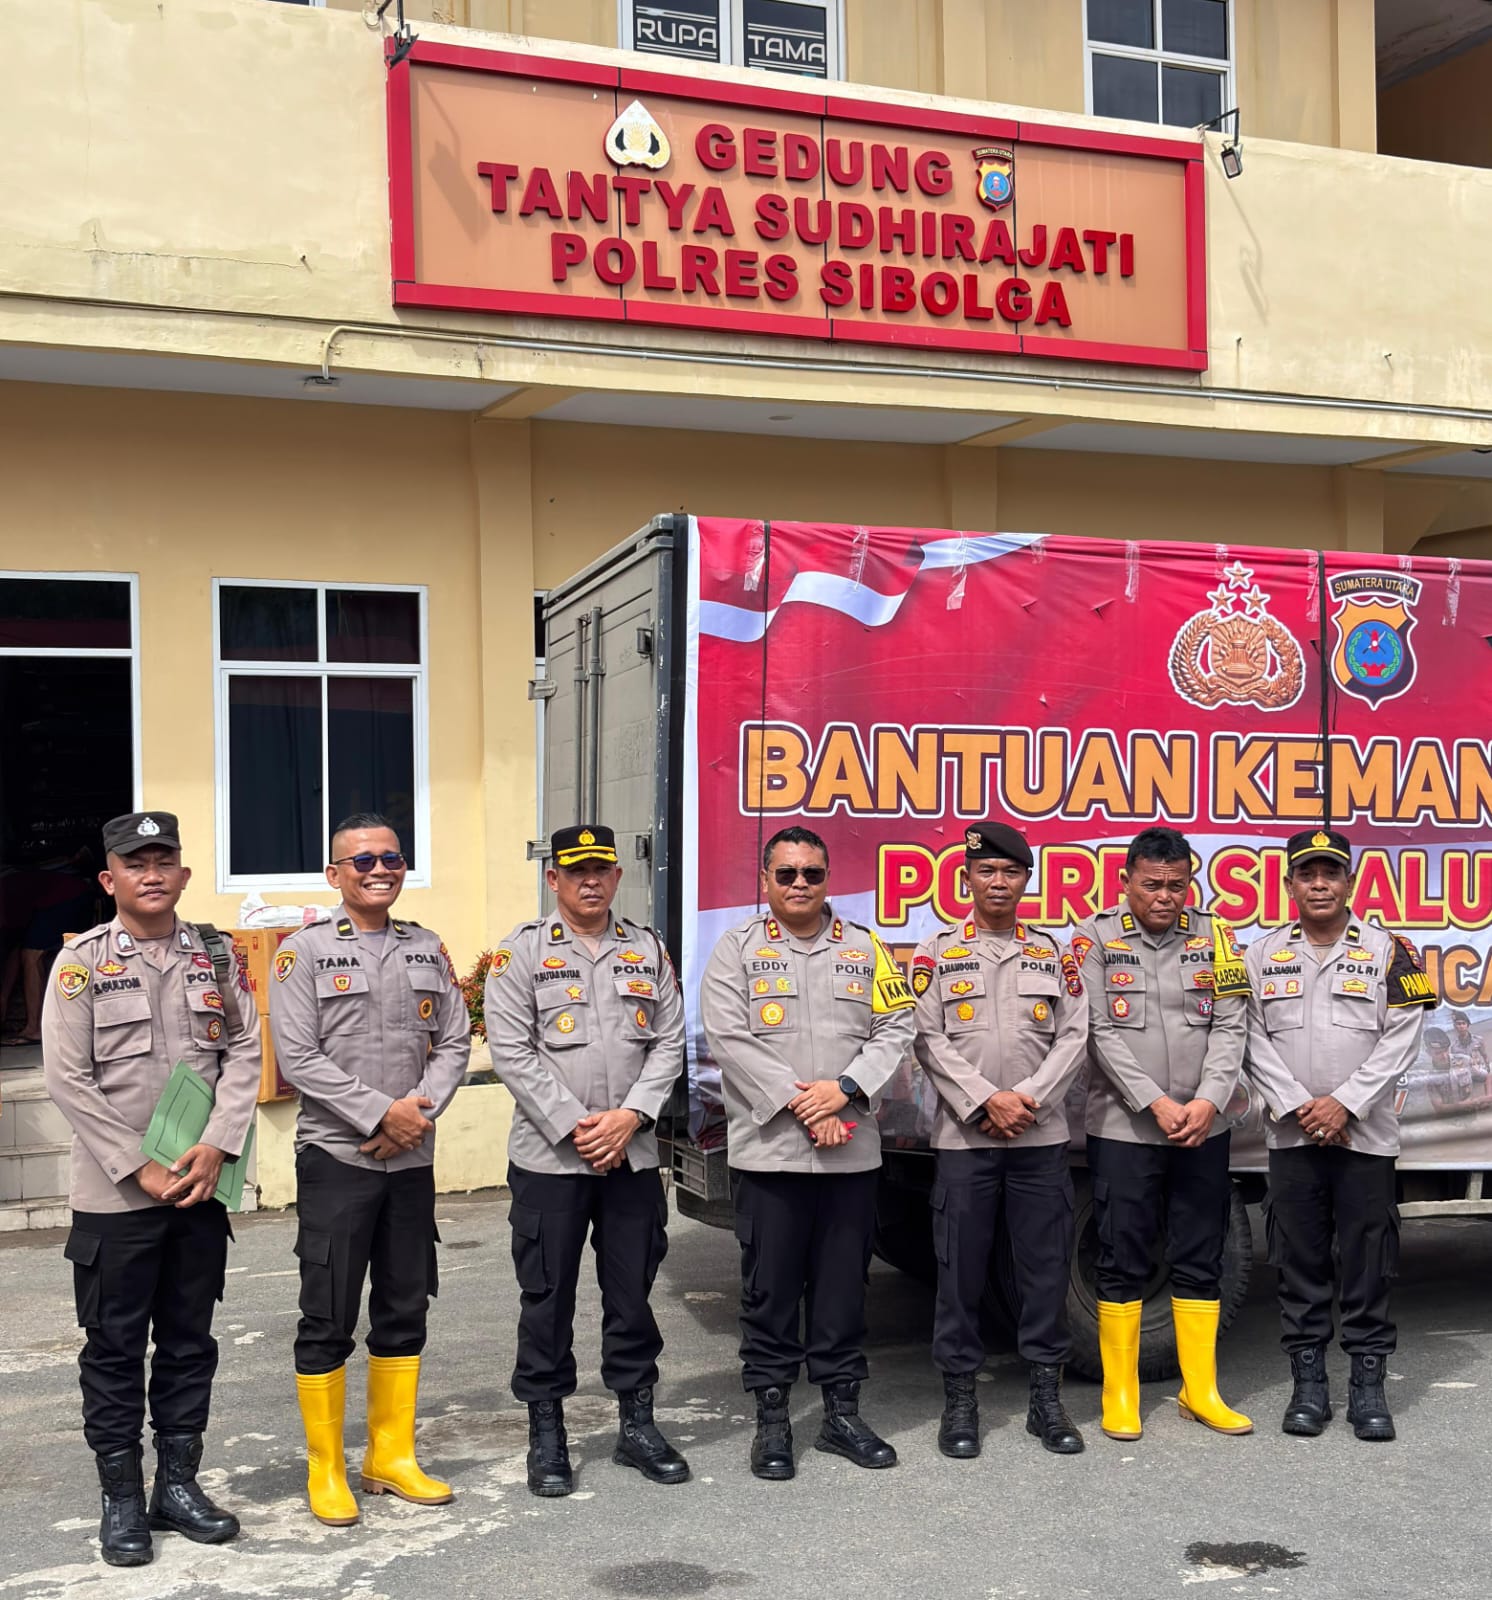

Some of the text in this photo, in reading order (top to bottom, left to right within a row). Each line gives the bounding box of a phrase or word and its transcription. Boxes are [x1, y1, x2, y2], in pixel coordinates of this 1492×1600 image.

[637, 18, 825, 63] RUPA TAMA
[695, 123, 952, 196] GEDUNG
[477, 161, 1134, 277] TANTYA SUDHIRAJATI
[551, 232, 1072, 327] POLRES SIBOLGA
[1335, 577, 1415, 597] SUMATERA UTARA
[740, 721, 1198, 822] BANTUAN
[1209, 846, 1492, 931] SIALU
[316, 957, 361, 970] TAMA
[613, 965, 657, 977] POLRI
[752, 961, 789, 972] EDDY
[835, 964, 874, 979] POLRI
[1021, 961, 1056, 975] POLRI
[1336, 963, 1379, 977] POLRI
